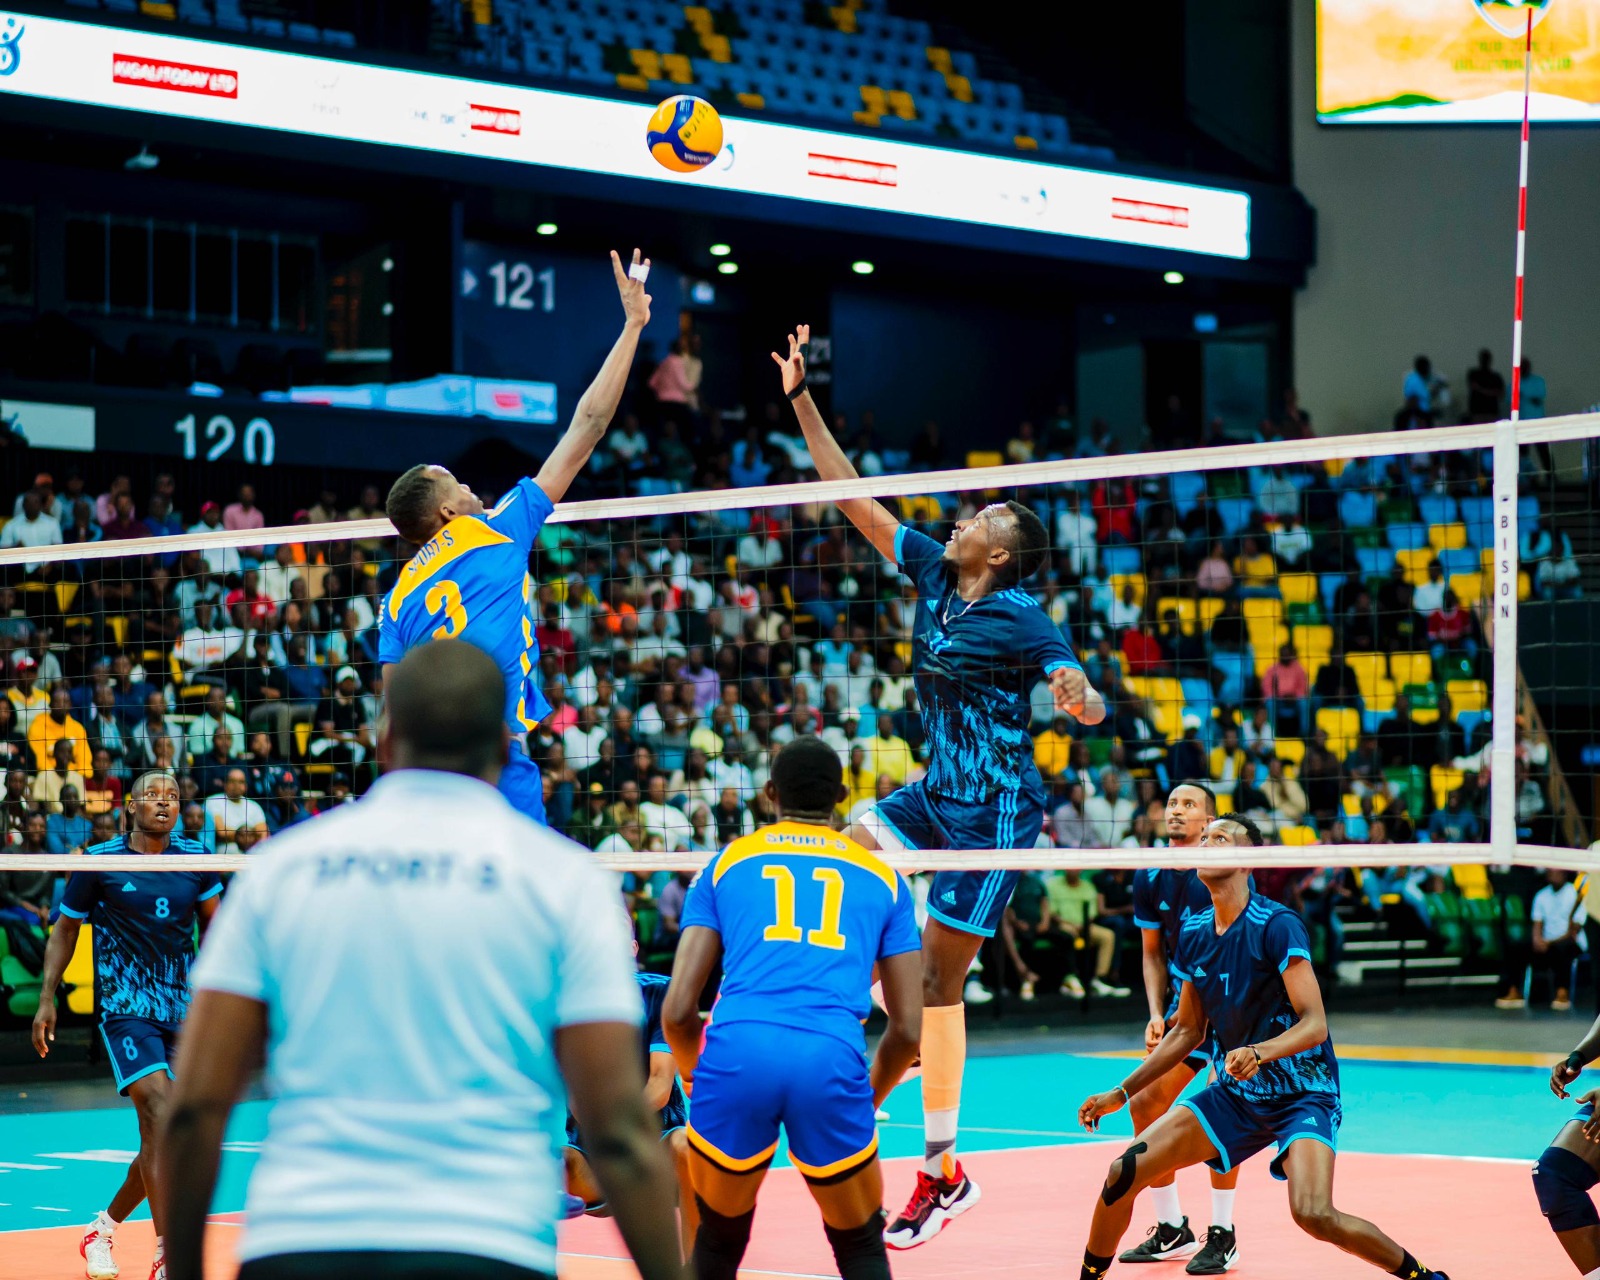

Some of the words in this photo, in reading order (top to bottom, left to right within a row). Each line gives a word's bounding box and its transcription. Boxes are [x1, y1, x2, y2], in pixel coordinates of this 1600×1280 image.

[209, 73, 237, 93] LTD
[487, 260, 556, 313] 121
[174, 412, 275, 466] 120
[1501, 515, 1510, 618] BISON
[425, 579, 468, 639] 3
[155, 897, 170, 919] 8
[761, 864, 847, 950] 11
[1219, 973, 1230, 996] 7
[122, 1035, 139, 1061] 8
